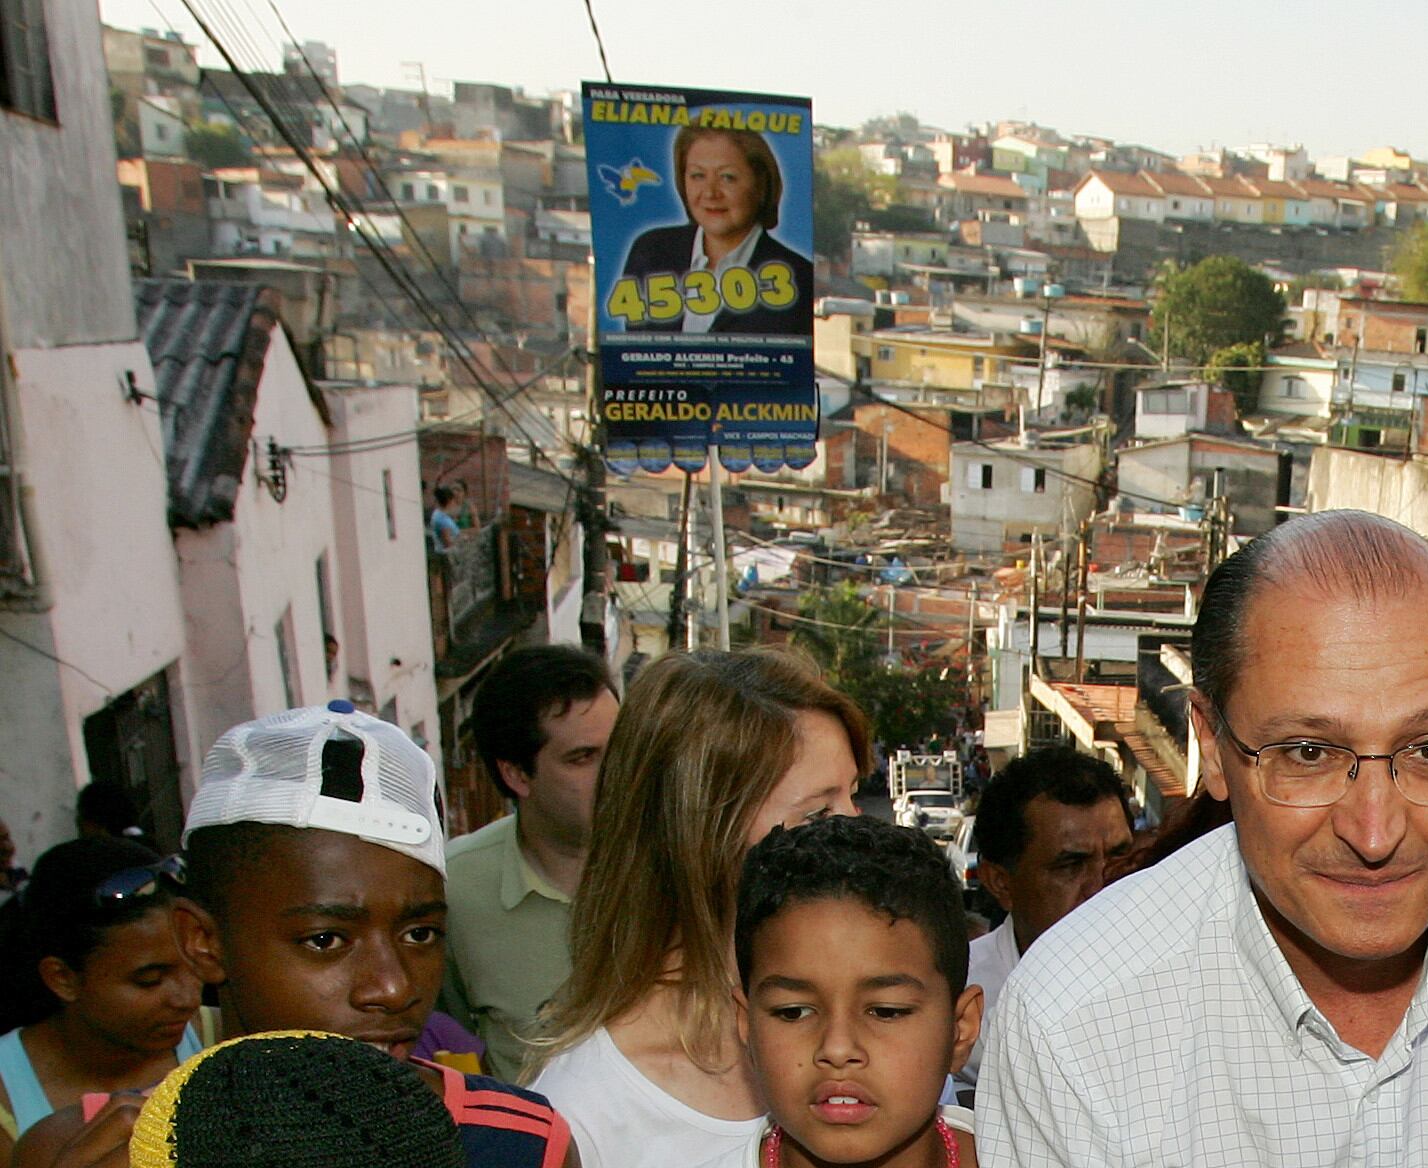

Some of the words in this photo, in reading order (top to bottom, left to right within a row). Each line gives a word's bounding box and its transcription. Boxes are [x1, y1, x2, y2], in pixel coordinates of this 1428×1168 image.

[591, 100, 690, 125] ELIANA
[701, 107, 803, 134] FALQUE
[607, 262, 796, 322] 45303
[621, 352, 672, 363] GERALDO
[674, 353, 724, 363] ALCKMIN
[604, 389, 688, 401] PREFEITO
[605, 402, 711, 421] GERALDO
[716, 403, 817, 422] ALCKMIN
